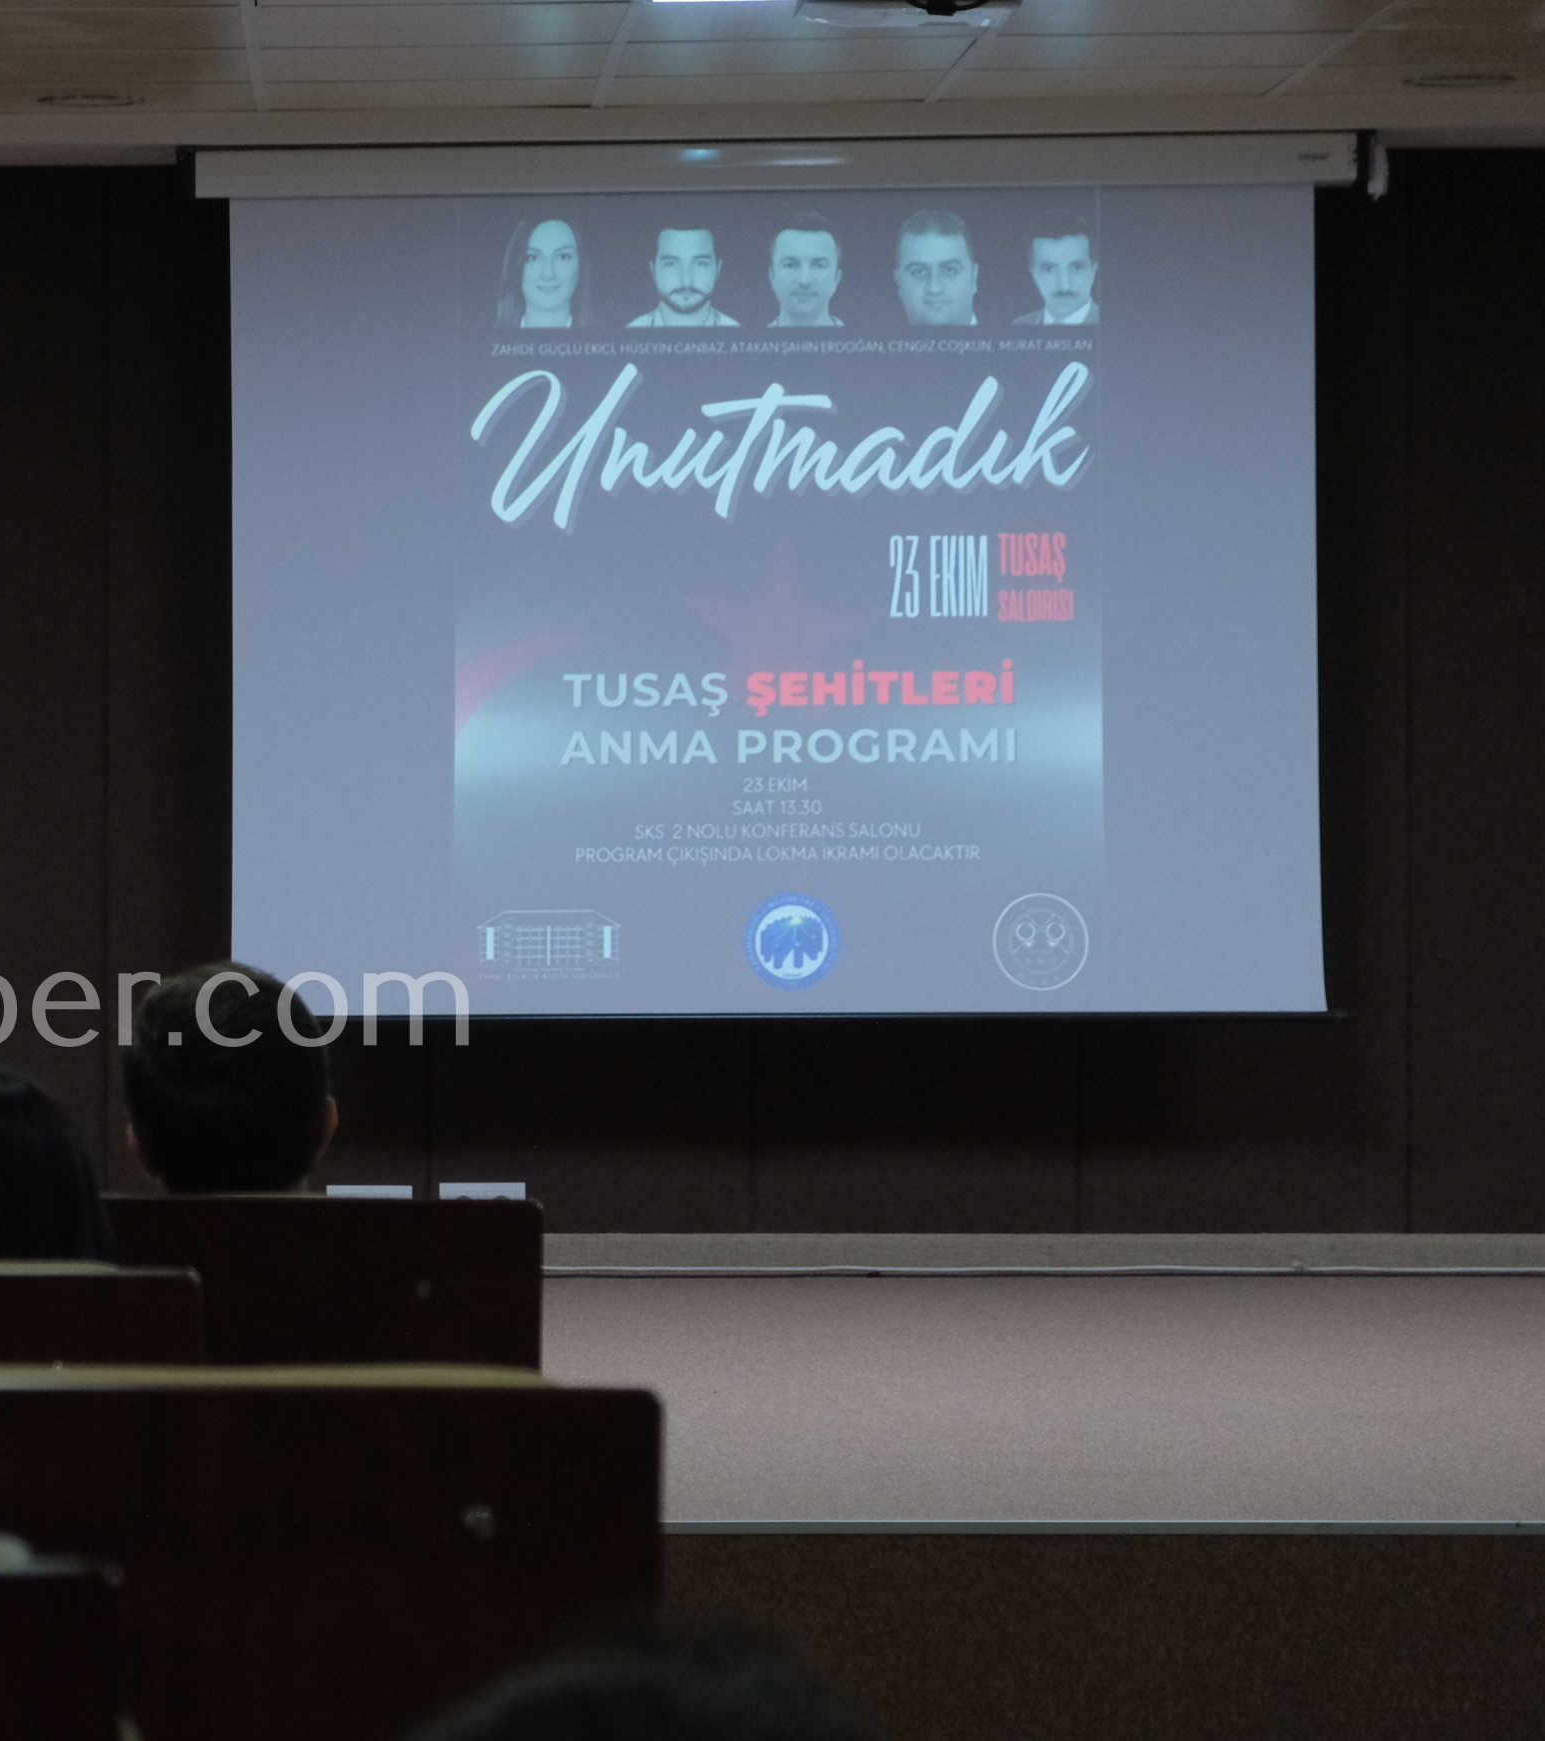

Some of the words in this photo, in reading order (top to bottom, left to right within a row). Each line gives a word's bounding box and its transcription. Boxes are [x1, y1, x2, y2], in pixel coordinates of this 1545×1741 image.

[470, 361, 1092, 530] Unutmadık
[890, 535, 920, 618] 23
[998, 532, 1066, 583] TUSAŞ
[562, 672, 729, 718] TUSAŞ
[746, 658, 1015, 718] ŞEHİTLERİ
[560, 730, 719, 766] ANMA
[737, 727, 1016, 765] PROGRAMI
[743, 777, 764, 793] 23
[733, 799, 775, 816] SAAT
[635, 823, 665, 840] SKS
[672, 823, 684, 840] 2
[686, 822, 736, 840] NOLU
[741, 822, 845, 840] KONFERANS
[847, 822, 922, 839] SALONU
[575, 846, 663, 864] PROGRAM
[666, 845, 753, 867] ÇIKIŞINDA
[756, 844, 818, 862] LOKMA
[884, 843, 982, 861] OLACAKTIR
